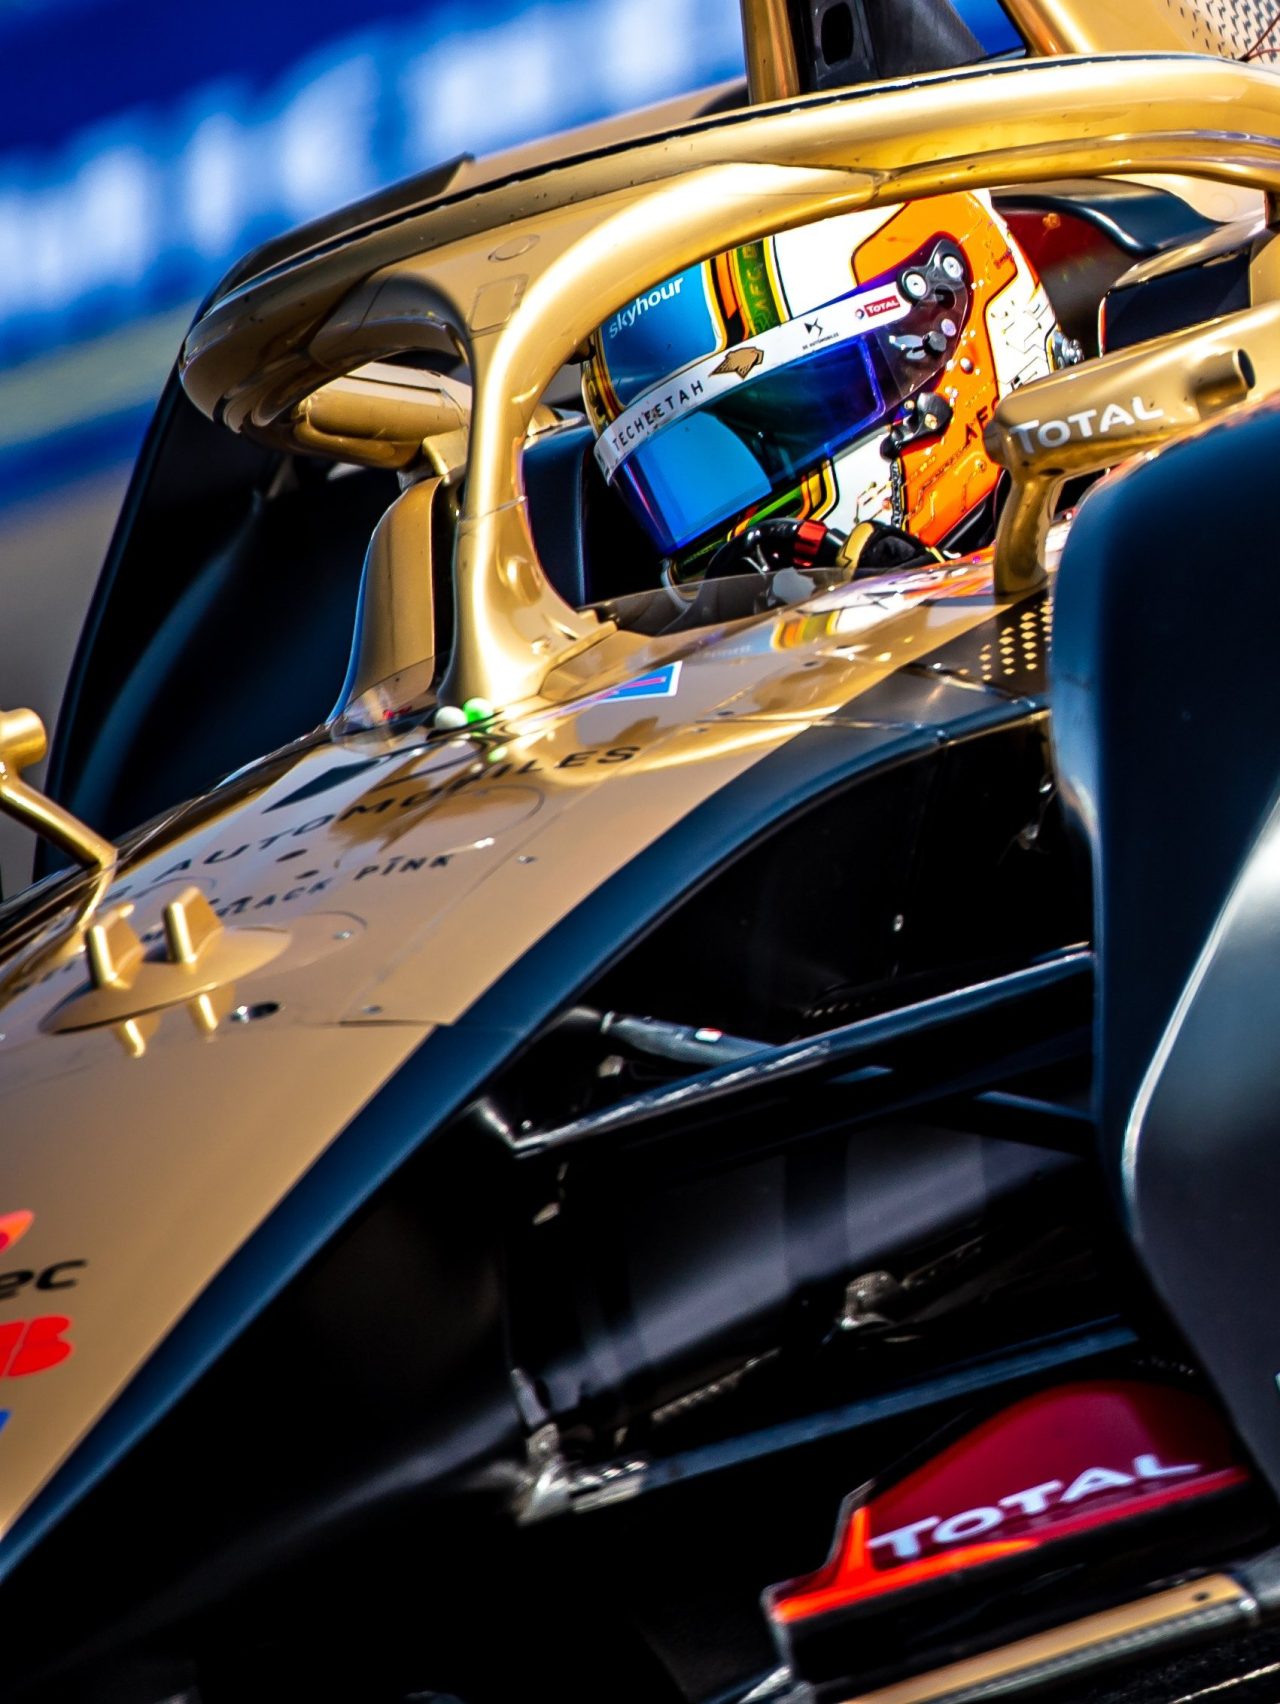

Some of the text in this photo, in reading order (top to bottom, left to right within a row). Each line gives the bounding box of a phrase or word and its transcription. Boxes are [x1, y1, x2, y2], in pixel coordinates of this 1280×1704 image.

[608, 277, 684, 339] skyhour
[866, 299, 899, 314] TOTAL
[612, 380, 704, 452] TECHEETAH
[1009, 396, 1165, 454] TOTAL
[865, 1454, 1201, 1559] TOTAL
